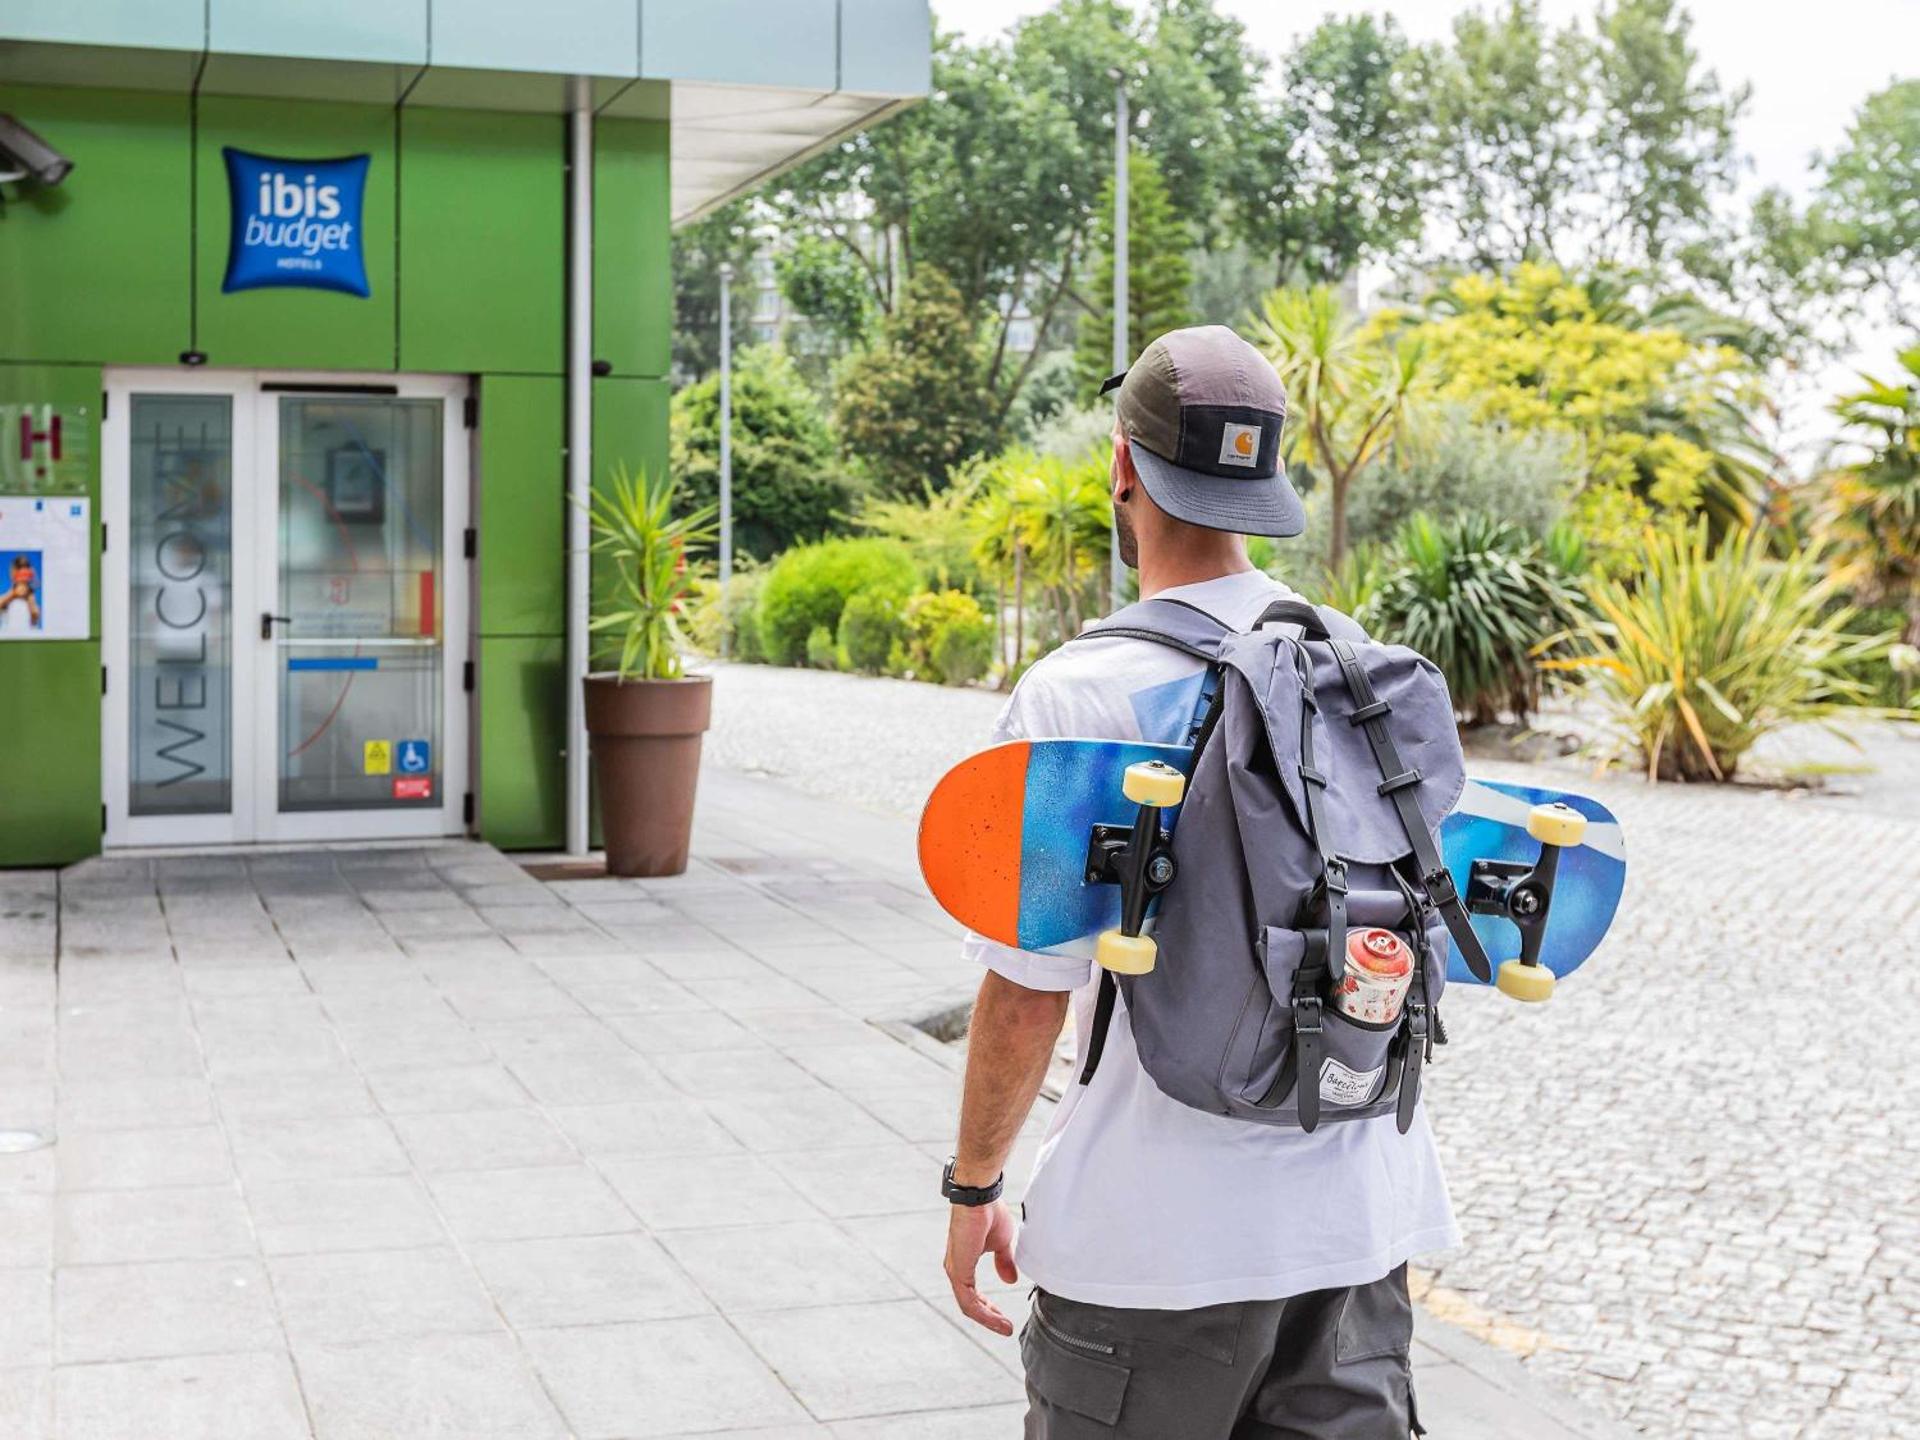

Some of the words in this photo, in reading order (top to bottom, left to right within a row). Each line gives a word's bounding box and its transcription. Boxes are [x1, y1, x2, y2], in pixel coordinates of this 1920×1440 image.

[260, 172, 341, 219] ibis
[244, 214, 353, 256] budget
[20, 414, 62, 462] H
[155, 421, 206, 788] WELCOME
